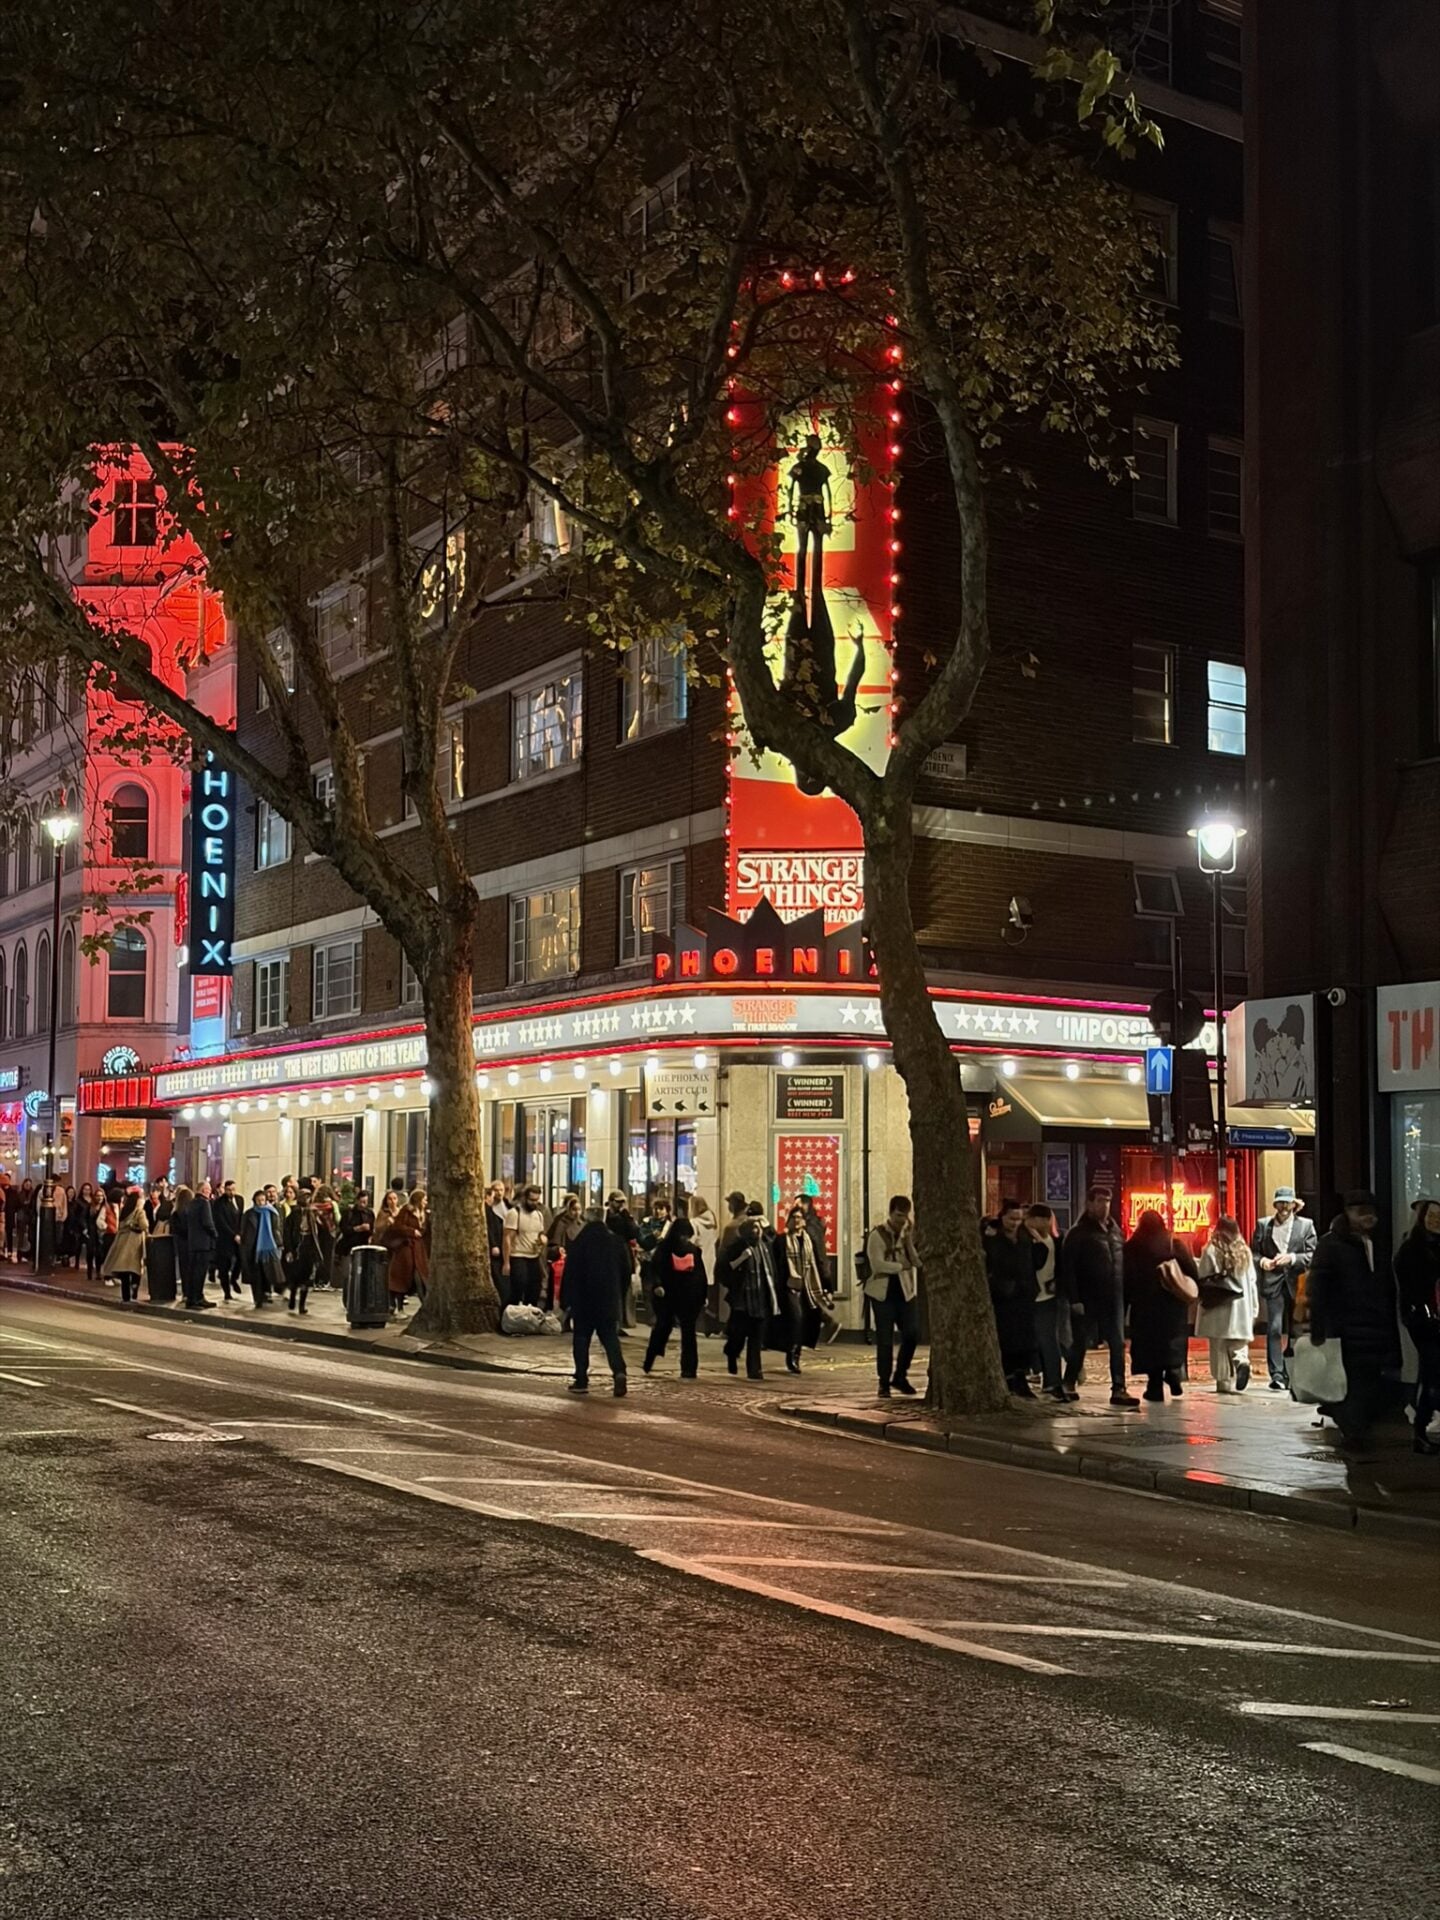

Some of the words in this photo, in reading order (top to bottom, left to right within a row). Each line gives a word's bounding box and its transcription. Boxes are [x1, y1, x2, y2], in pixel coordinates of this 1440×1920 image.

[927, 751, 954, 763] HOENIX
[201, 750, 229, 967] HOENIX
[732, 1000, 798, 1016] STRANGER
[743, 1011, 787, 1023] THINGS
[103, 1045, 140, 1064] CHIPOTLE
[301, 1055, 321, 1076] WEST
[322, 1053, 339, 1074] END
[340, 1048, 366, 1071] EVENT
[366, 1046, 379, 1068] OF
[379, 1043, 396, 1066] THE
[654, 1073, 671, 1083] THE
[671, 1072, 710, 1082] PHOENIX
[793, 1078, 827, 1086] WINNER!
[654, 1086, 684, 1095] ARTIST
[685, 1086, 708, 1095] CLUB
[793, 1099, 827, 1107] WINNER!
